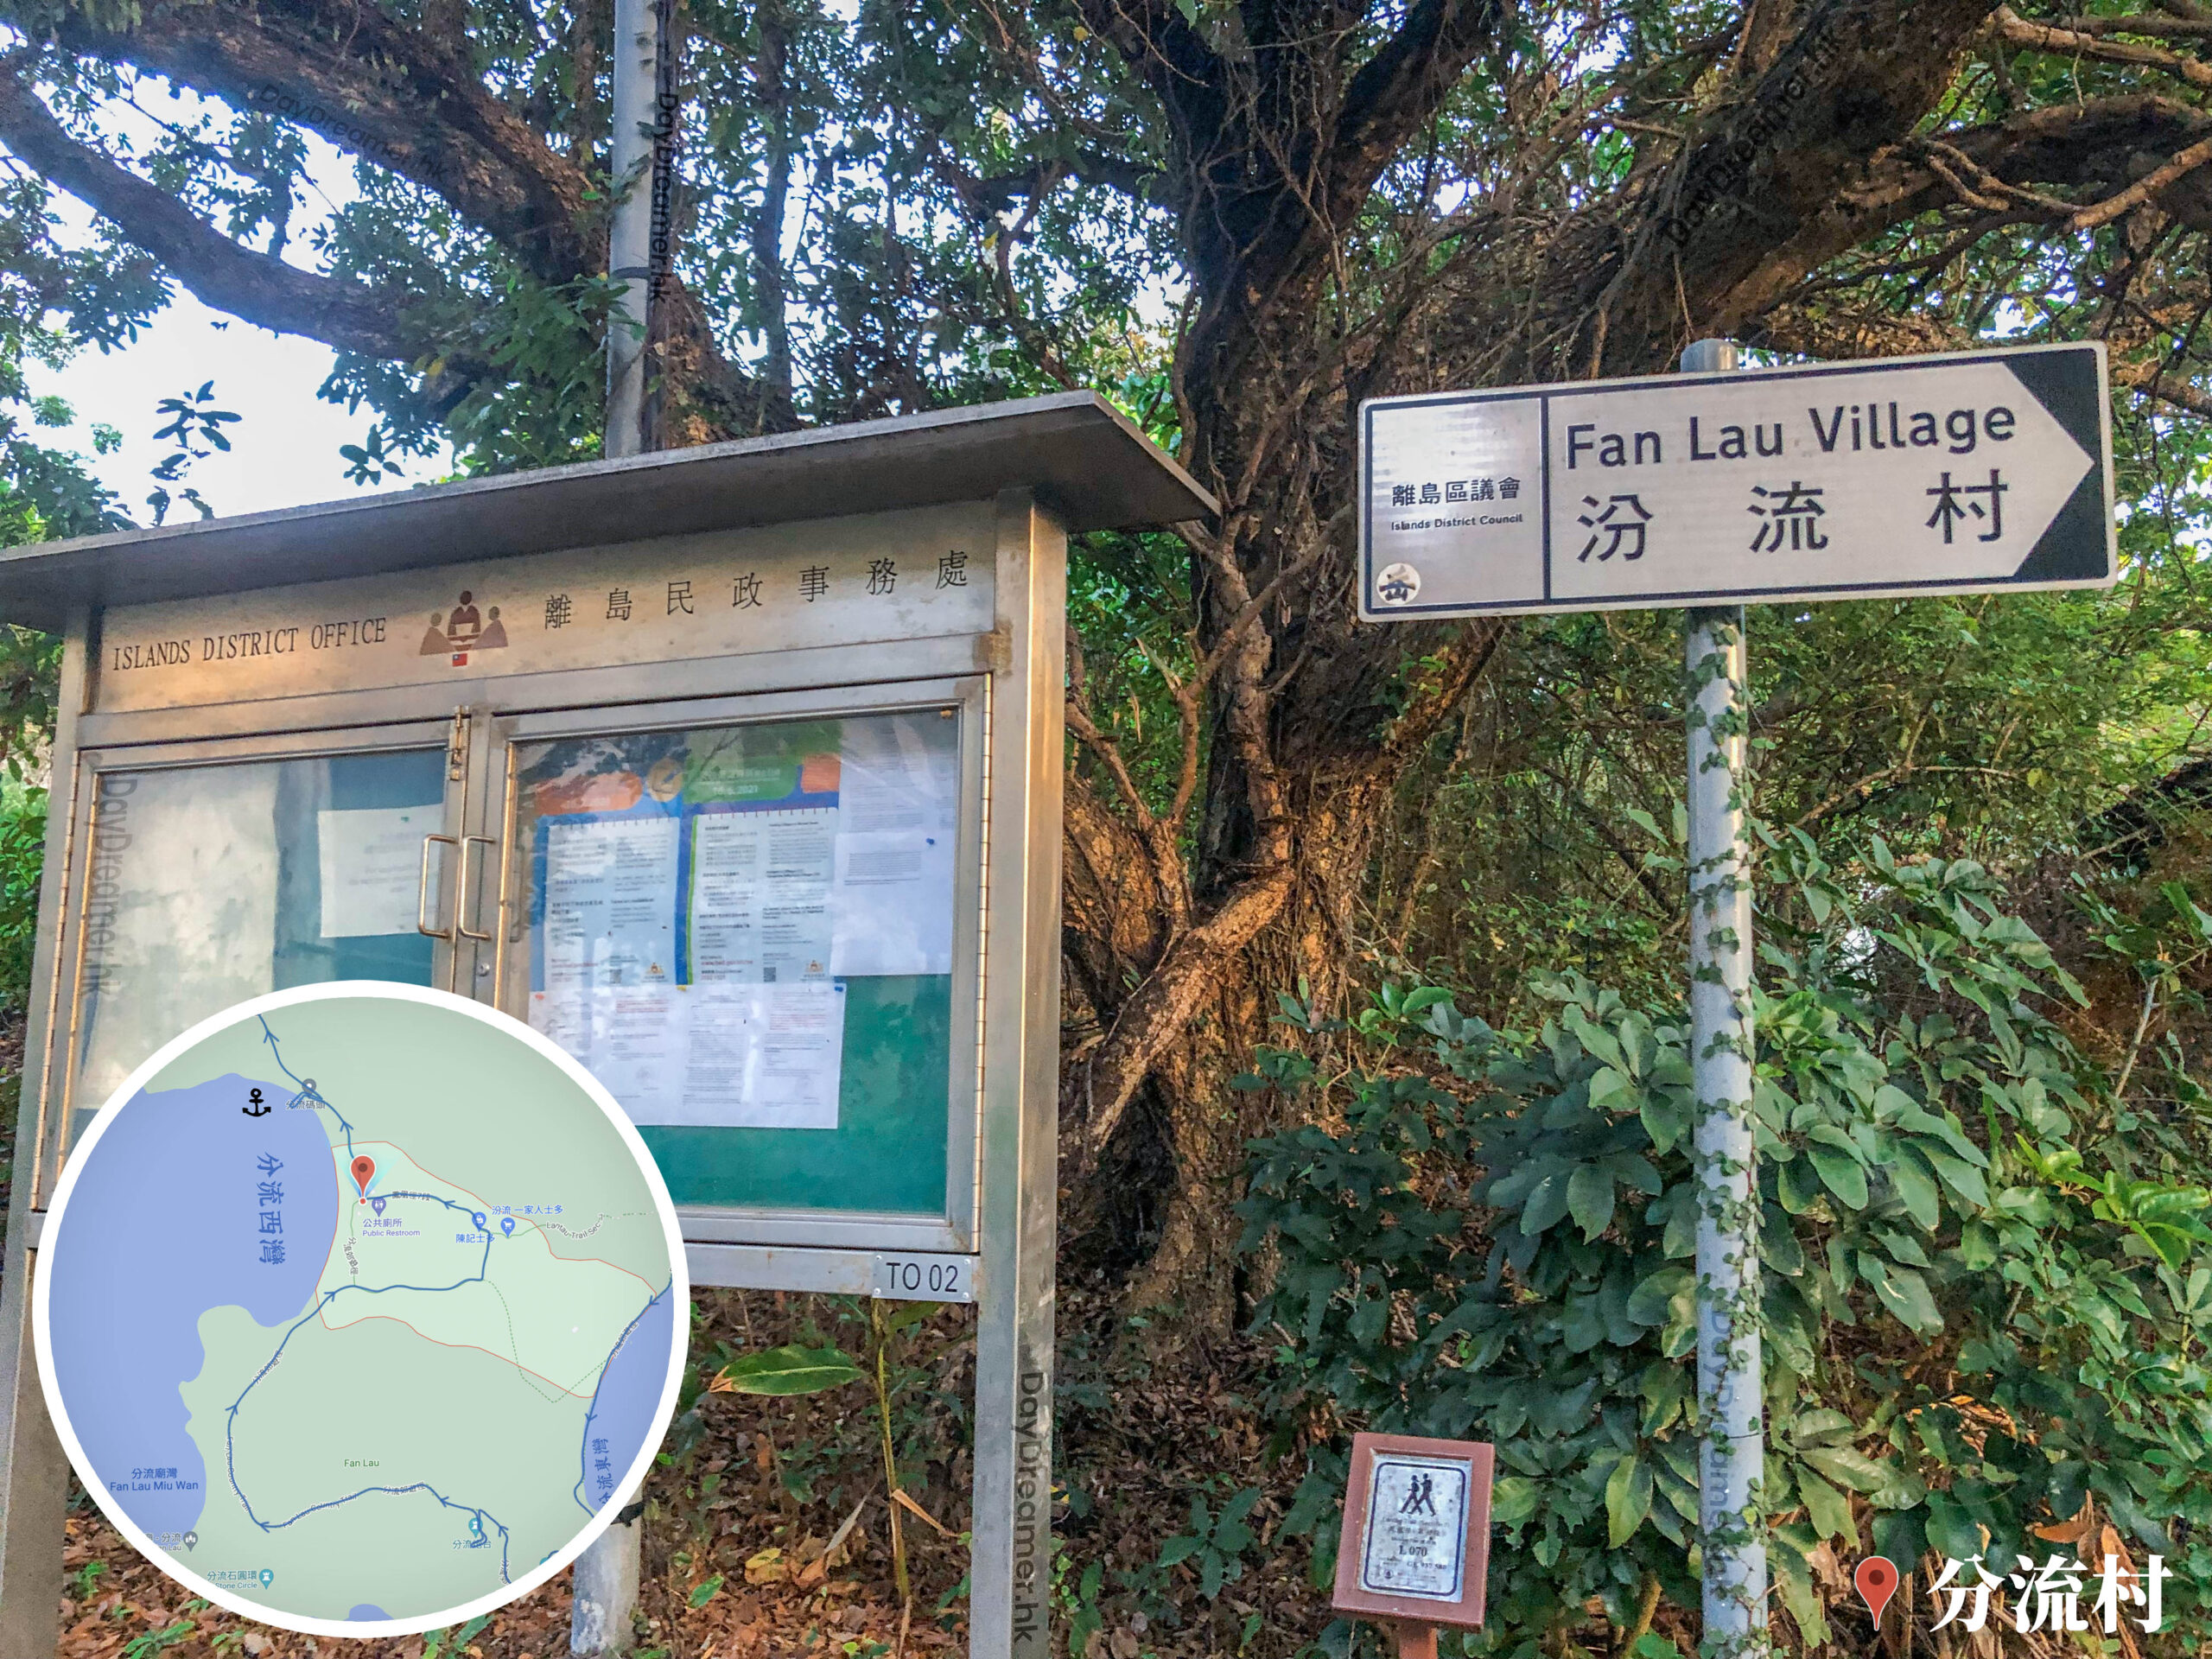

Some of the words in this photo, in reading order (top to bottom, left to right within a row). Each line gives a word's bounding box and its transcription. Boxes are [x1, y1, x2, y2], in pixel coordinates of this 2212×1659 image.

[1565, 423, 1662, 470] Fan
[1689, 415, 1783, 462] Lau
[1807, 400, 2017, 460] Village
[1391, 477, 1521, 507] 離島區議會
[1391, 519, 1431, 531] Islands
[1434, 516, 1476, 528] District
[1479, 513, 1523, 525] Council
[1576, 469, 2010, 563] 汾流村
[543, 550, 969, 632] 離島民政事務處
[112, 639, 190, 672] ISLANDS
[200, 628, 300, 664] DISTRICT
[310, 617, 387, 653] OFFICE
[886, 1262, 920, 1290] TO
[929, 1264, 958, 1293] 02
[1399, 1545, 1407, 1555] L
[1409, 1546, 1427, 1557] 070
